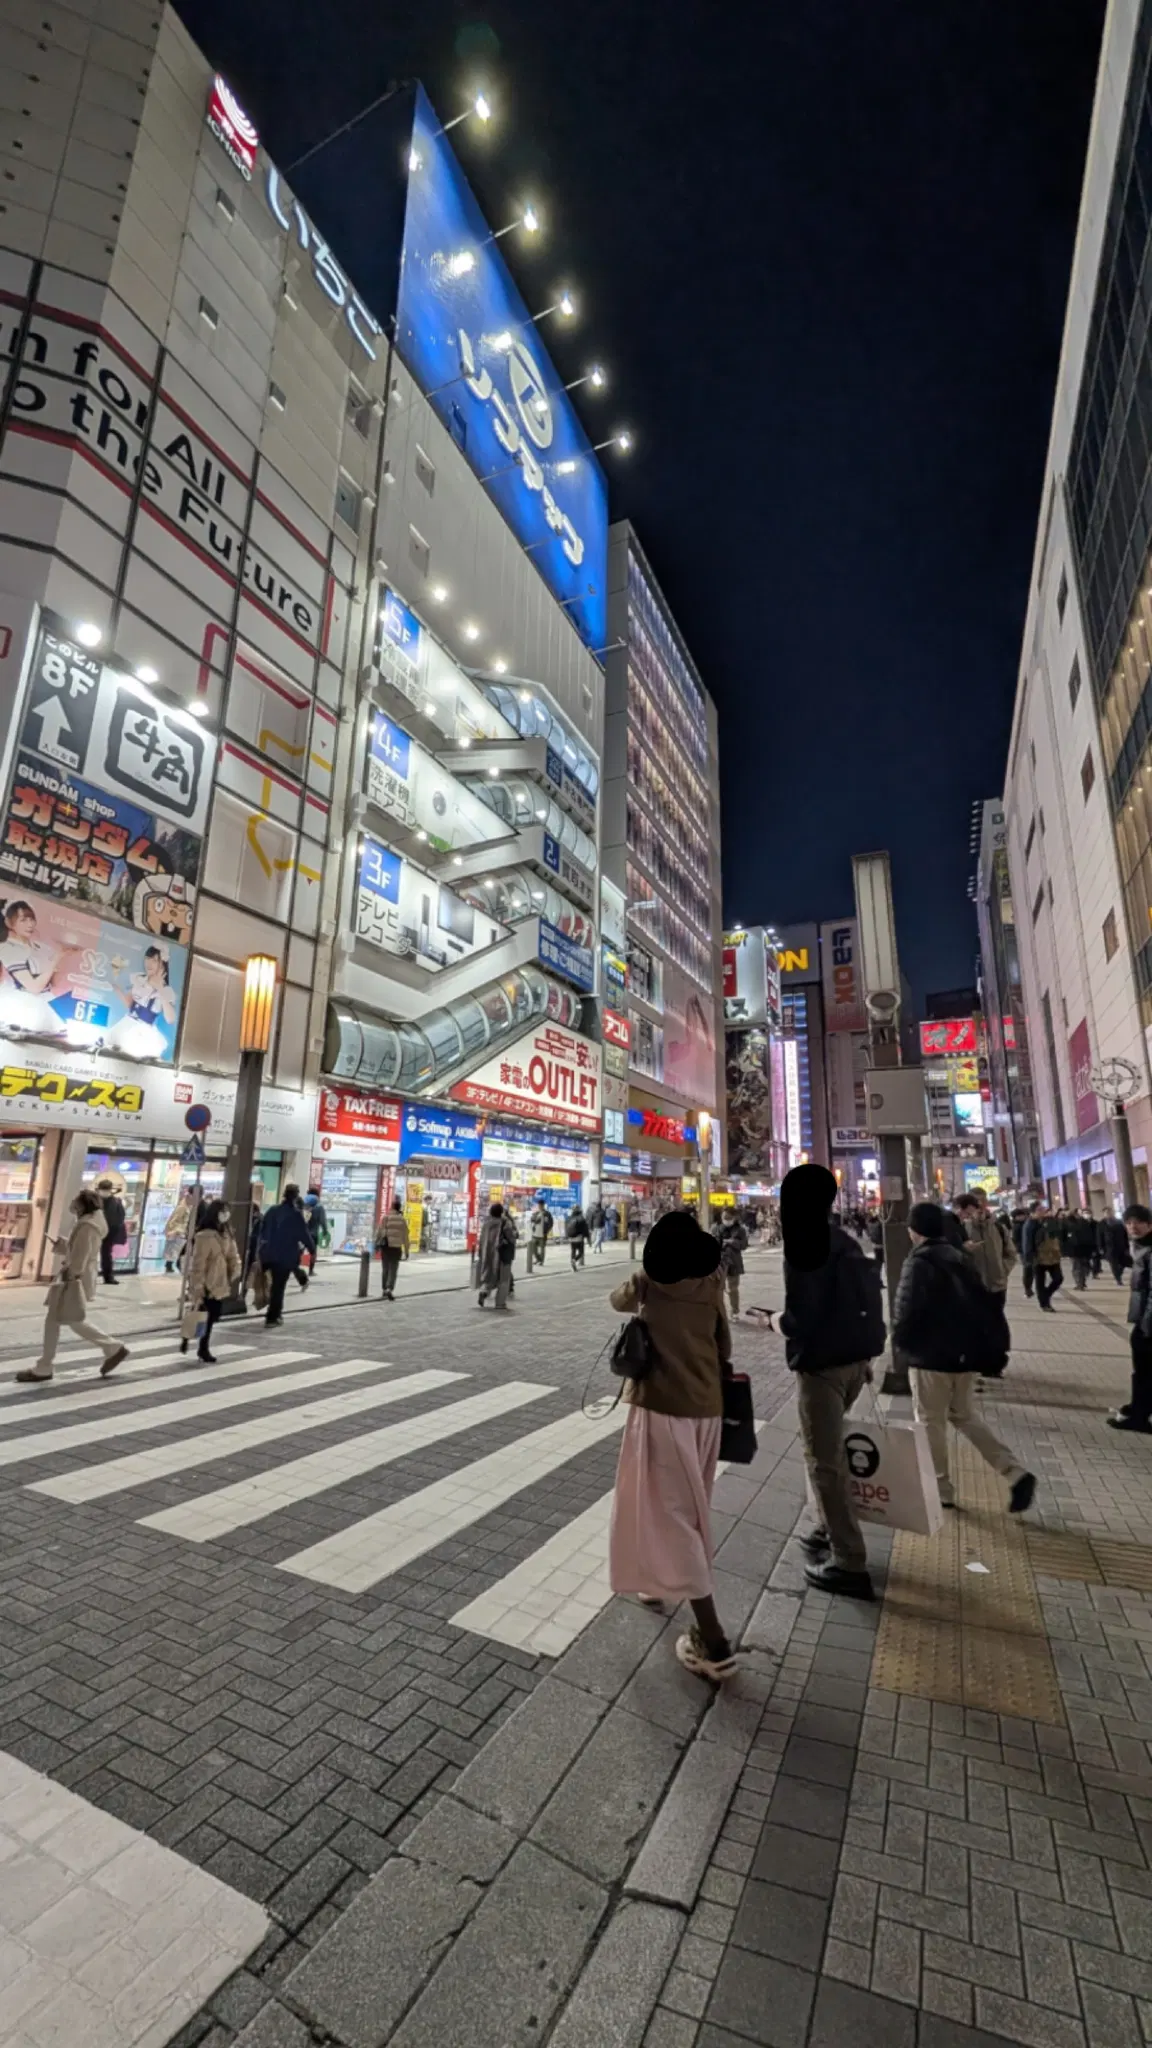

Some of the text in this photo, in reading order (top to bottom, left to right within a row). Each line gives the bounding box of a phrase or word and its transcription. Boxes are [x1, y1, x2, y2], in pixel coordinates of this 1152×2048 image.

[205, 114, 252, 182] ICHIGO
[164, 433, 226, 506] All
[69, 392, 163, 496] the
[178, 487, 313, 633] Future
[388, 602, 411, 644] 5F
[41, 653, 95, 699] 8F
[45, 635, 99, 675] このビル
[124, 718, 190, 795] 牛角
[378, 723, 401, 763] 4F
[17, 763, 117, 819] GUNDAM shop
[368, 783, 418, 827] エアコン
[11, 783, 160, 874] ガンダム
[0, 850, 79, 892] 当ビル7F
[6, 818, 115, 887] 取扱店
[367, 847, 392, 890] 3F
[359, 893, 399, 930] テレビ
[74, 1001, 99, 1024] 6F
[604, 1014, 630, 1044] アコム
[529, 1055, 598, 1110] OUTLET
[71, 1108, 144, 1121] STADIUM
[343, 1095, 400, 1120] TAX FREE
[418, 1119, 452, 1139] Sofmap
